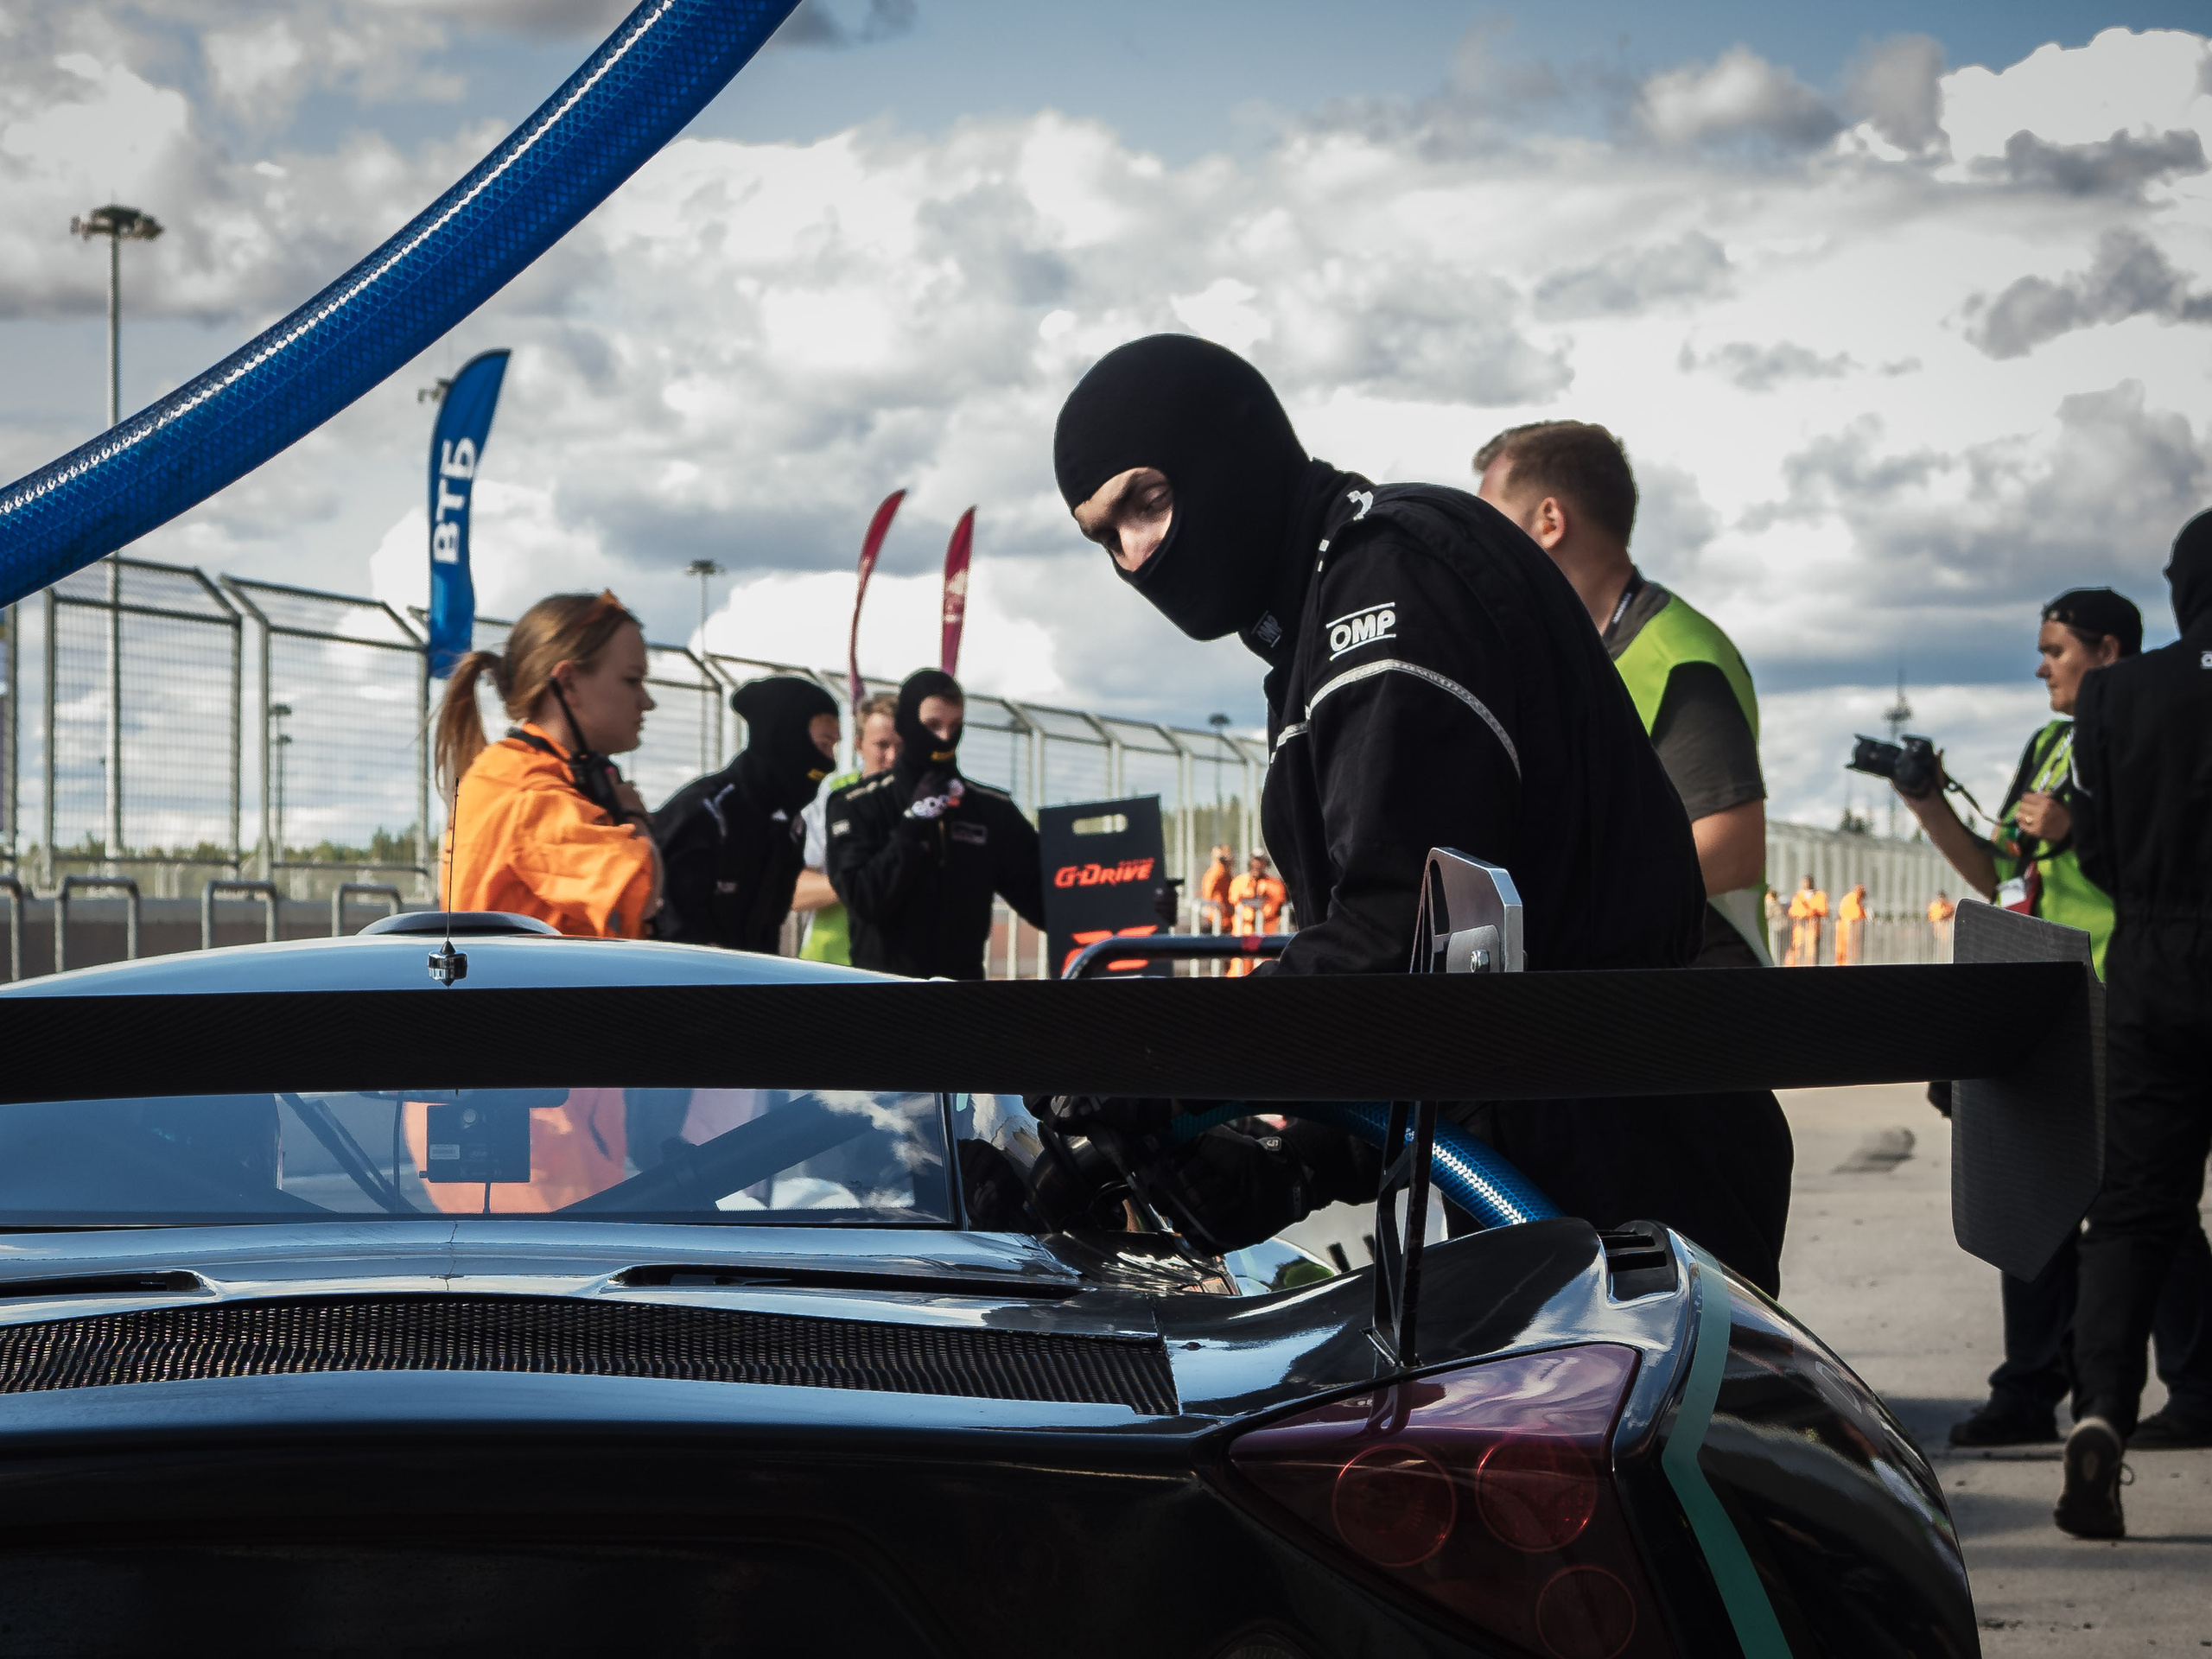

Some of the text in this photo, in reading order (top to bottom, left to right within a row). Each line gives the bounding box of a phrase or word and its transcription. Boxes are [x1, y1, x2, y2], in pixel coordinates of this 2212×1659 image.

[433, 437, 476, 565] ВТБ
[1255, 614, 1282, 644] OMP
[1330, 610, 1396, 652] OMP
